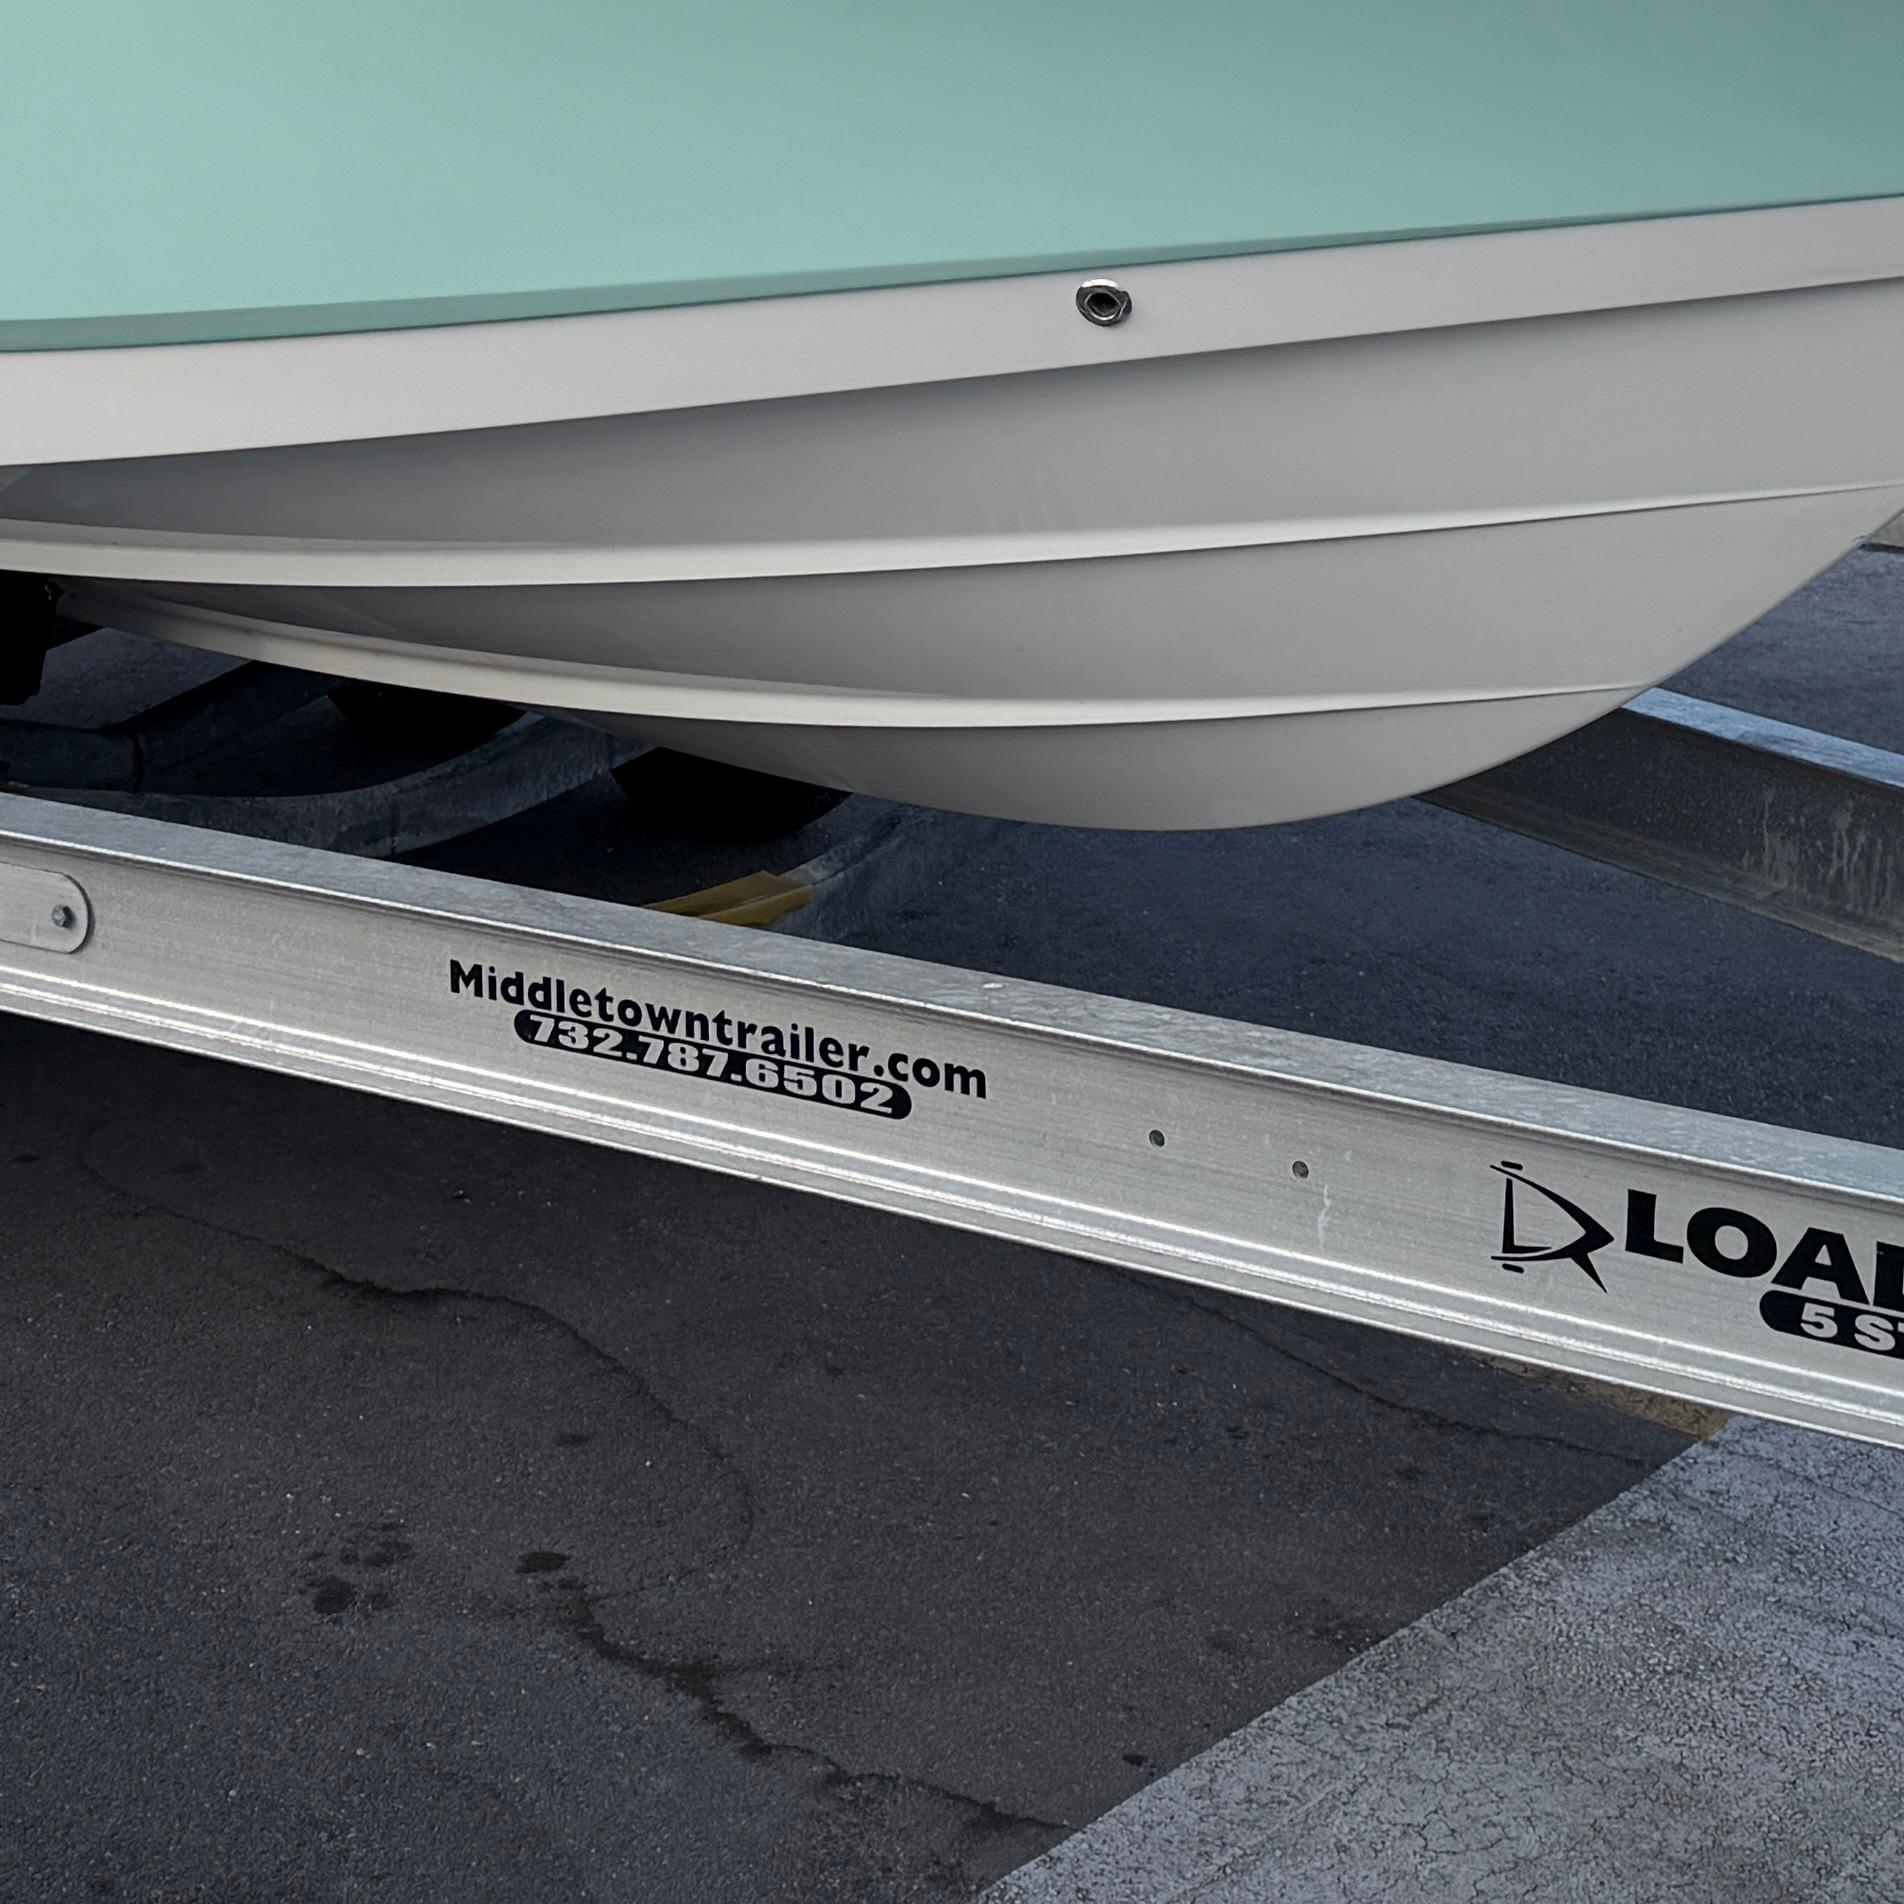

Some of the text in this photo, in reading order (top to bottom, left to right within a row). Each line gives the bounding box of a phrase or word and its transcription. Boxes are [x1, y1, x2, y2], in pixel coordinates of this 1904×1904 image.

[449, 959, 988, 1099] Middletowntrailer.com
[526, 1013, 895, 1116] 732.787.6502
[1799, 1307, 1836, 1340] 5
